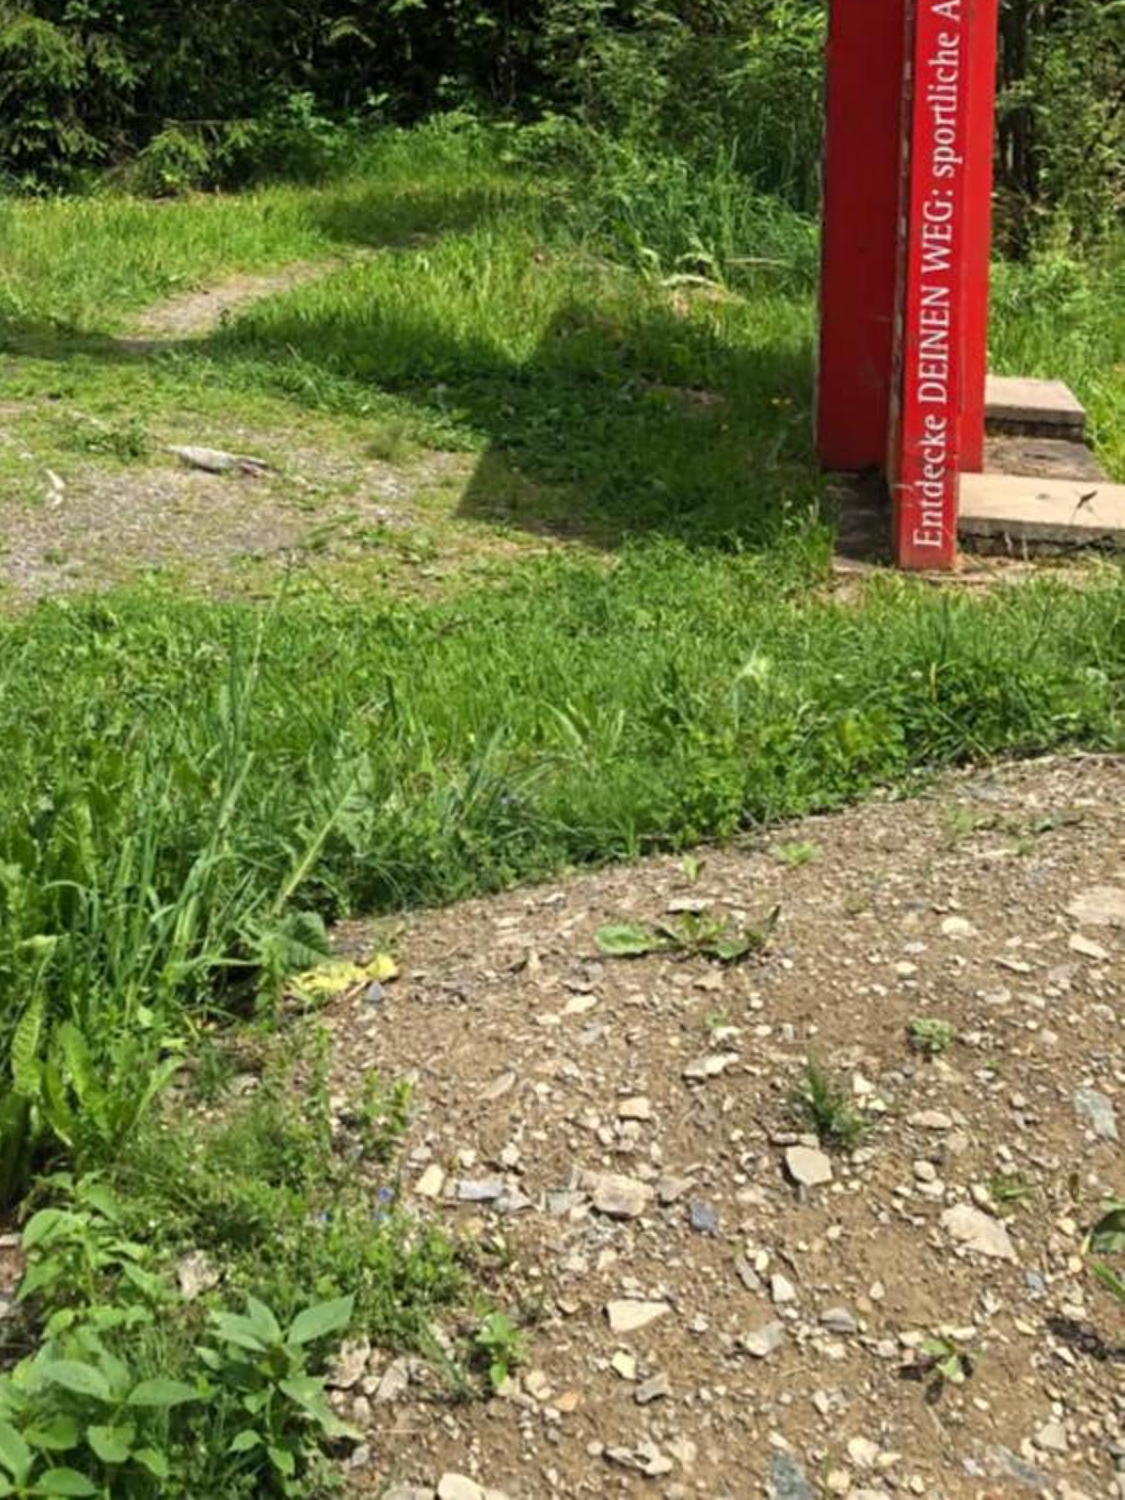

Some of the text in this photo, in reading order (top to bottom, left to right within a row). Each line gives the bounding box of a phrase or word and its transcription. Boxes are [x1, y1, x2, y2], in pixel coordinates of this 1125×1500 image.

[926, 32, 963, 178] sportliche
[922, 188, 954, 274] WEG:
[917, 286, 952, 404] DEINEN
[913, 414, 948, 550] Entdecke
